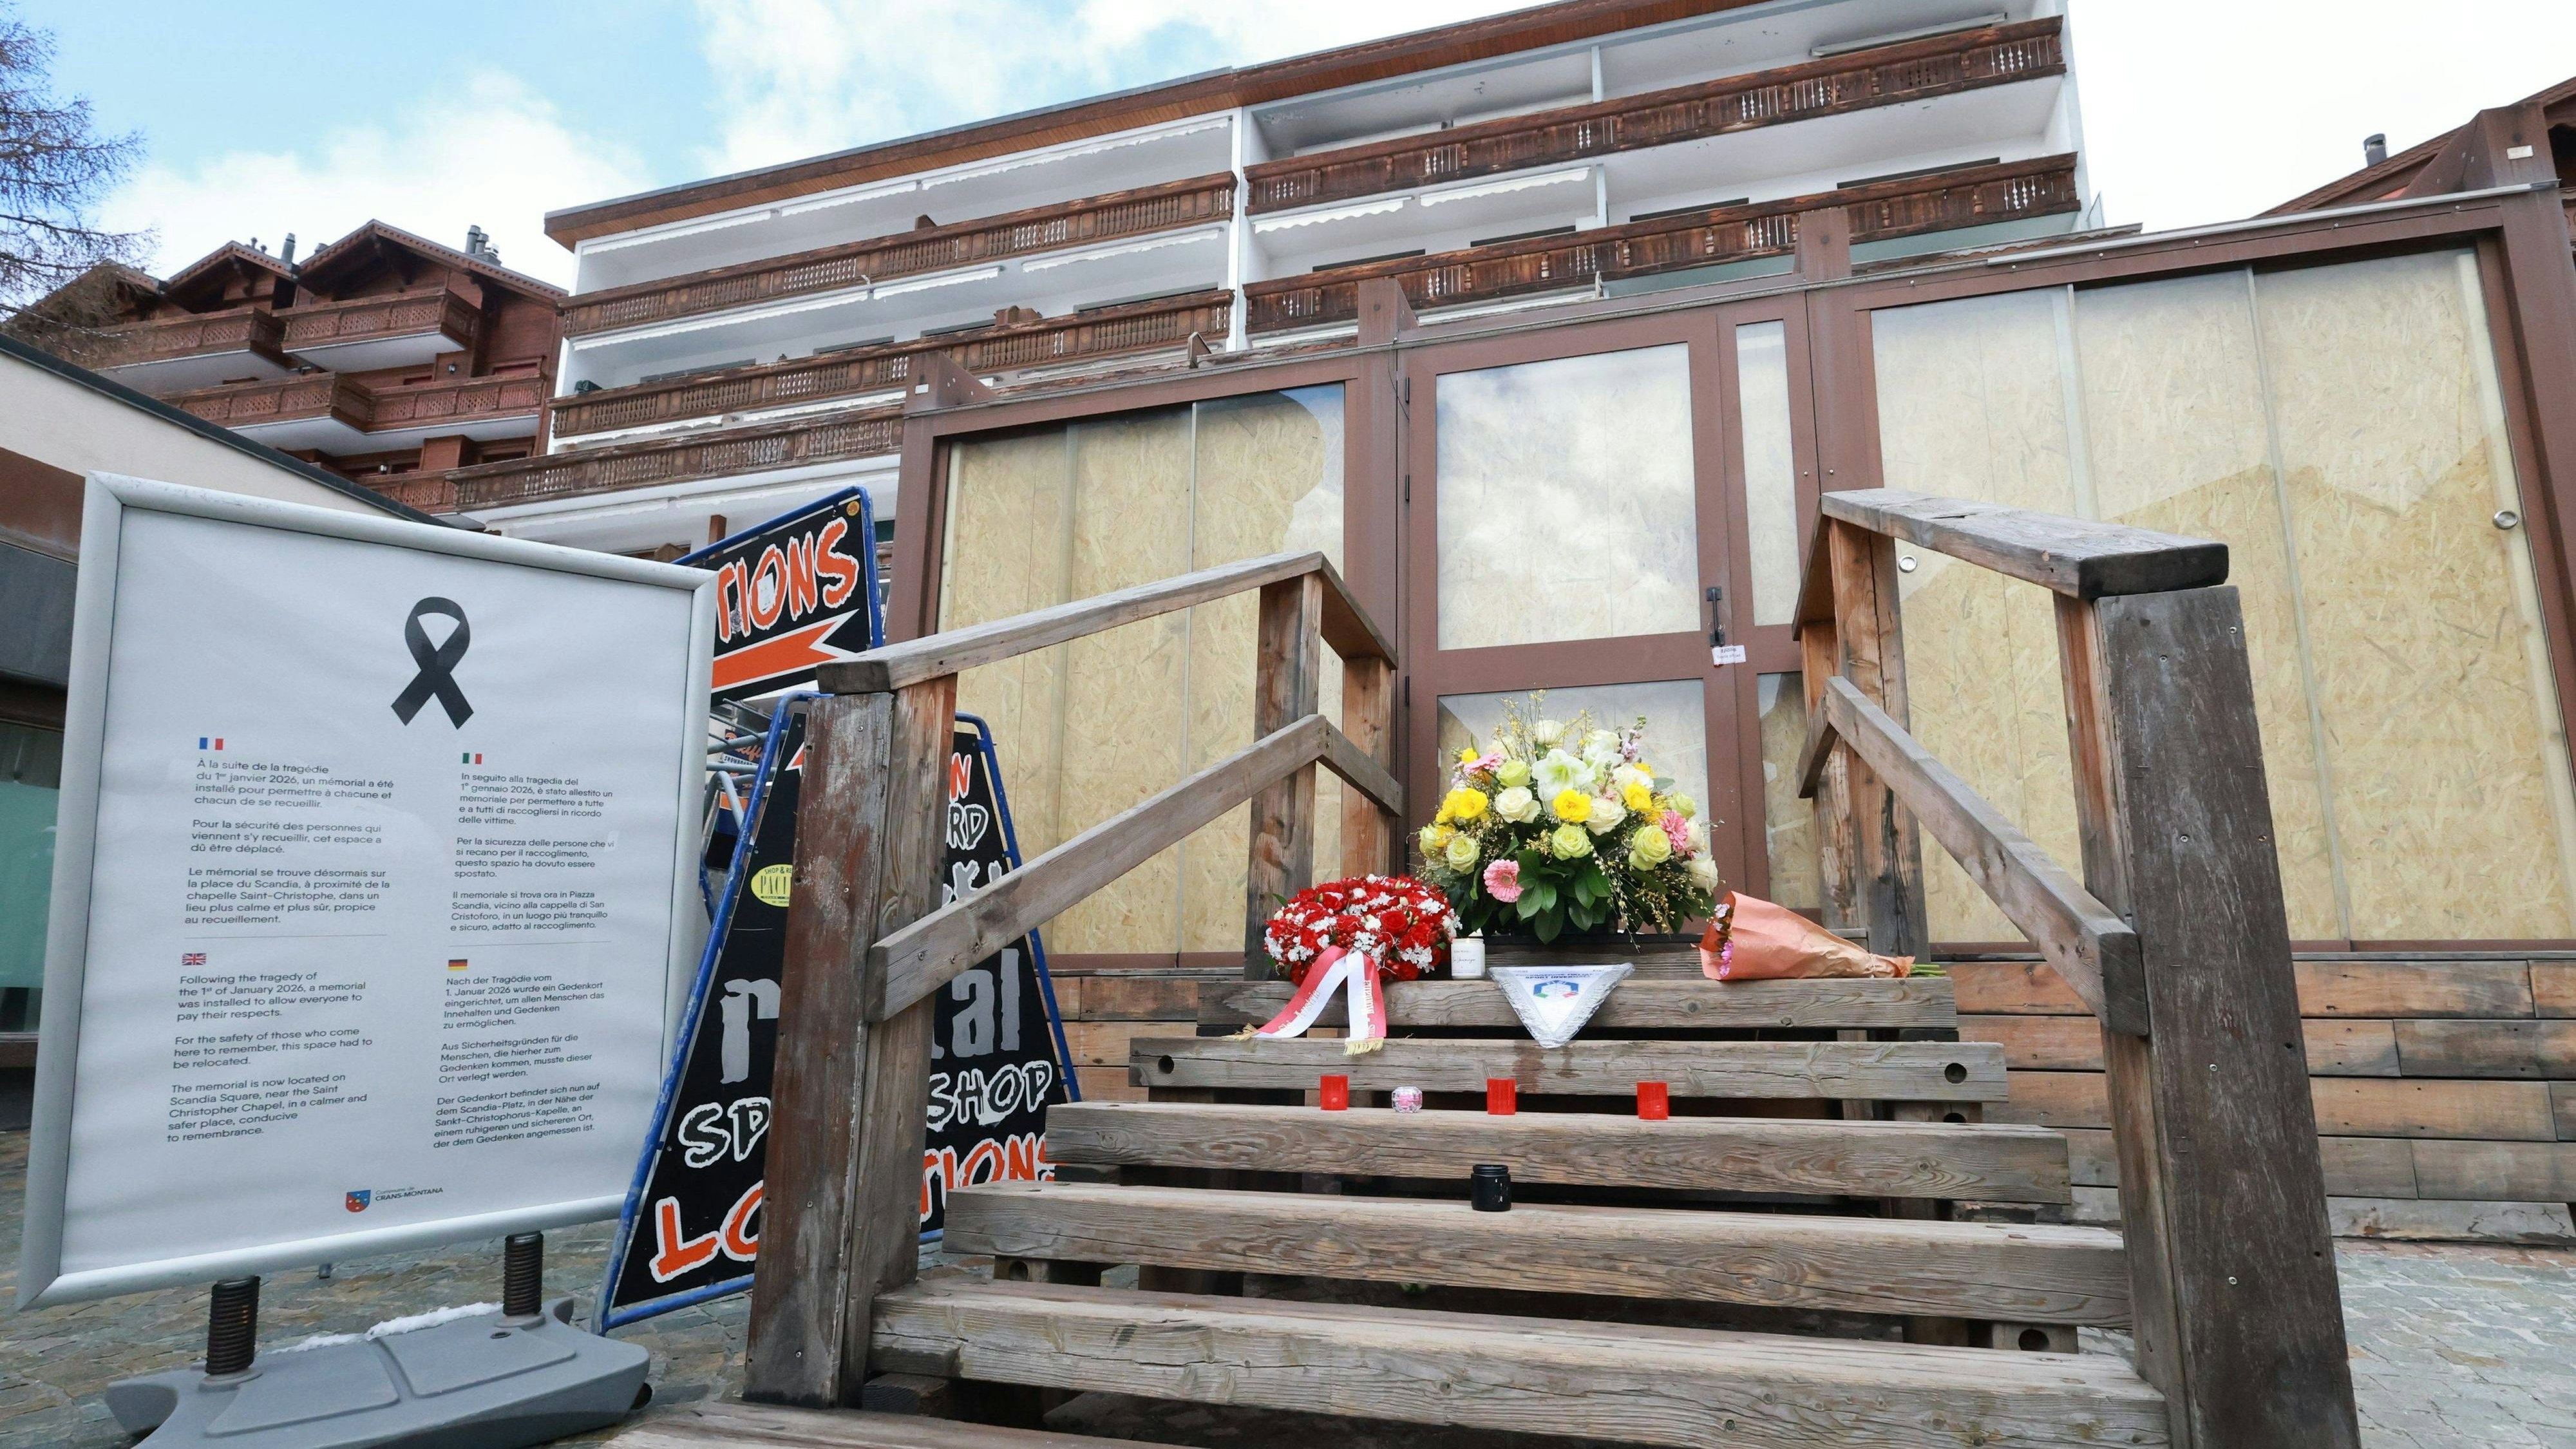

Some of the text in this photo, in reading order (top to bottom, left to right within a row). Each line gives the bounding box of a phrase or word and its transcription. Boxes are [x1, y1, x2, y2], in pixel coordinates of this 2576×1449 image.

[198, 759, 205, 768] À
[209, 760, 218, 768] la
[222, 761, 249, 770] suite
[283, 764, 328, 774] tragédie
[527, 777, 562, 785] tragedia
[193, 819, 218, 828] Pour
[235, 821, 279, 829] sécurité
[365, 825, 381, 833] qui
[236, 844, 285, 854] déplacé.
[491, 860, 520, 868] spazio
[314, 869, 368, 877] désormais
[187, 891, 236, 901] chapelle
[209, 904, 233, 913] plus
[287, 904, 310, 913] plus
[334, 904, 375, 913] propice
[202, 915, 281, 923] recueillement.
[533, 922, 596, 931] raccoglimento.
[180, 975, 235, 985] Following
[260, 973, 303, 983] tragedy
[306, 972, 317, 980] of
[493, 975, 531, 985] Tragödie
[1293, 990, 1320, 1020] Austria
[177, 1009, 283, 1022] pay their respects.
[444, 1009, 491, 1018] Innehalten
[514, 1005, 560, 1014] Gedenken
[457, 1019, 516, 1028] ermöglichen.
[220, 1034, 253, 1043] safety
[256, 1032, 268, 1040] of
[462, 1037, 549, 1049] Sicherheitsgründen
[440, 1052, 491, 1061] Menschen,
[193, 1057, 251, 1068] relocated.
[457, 1072, 489, 1081] verlegt
[493, 1070, 528, 1078] werden.
[173, 1084, 192, 1093] The
[196, 1080, 247, 1091] memorial
[288, 1074, 330, 1084] located
[170, 1095, 216, 1106] Scandia
[220, 1094, 262, 1103] Square,
[313, 1085, 337, 1094] Saint
[457, 1092, 507, 1103] Gedenkort
[509, 1088, 547, 1098] befindet
[168, 1112, 298, 1130] safer place, conducive
[183, 1128, 264, 1141] remembrance.
[375, 1187, 444, 1202] CRANS-MONTANA
